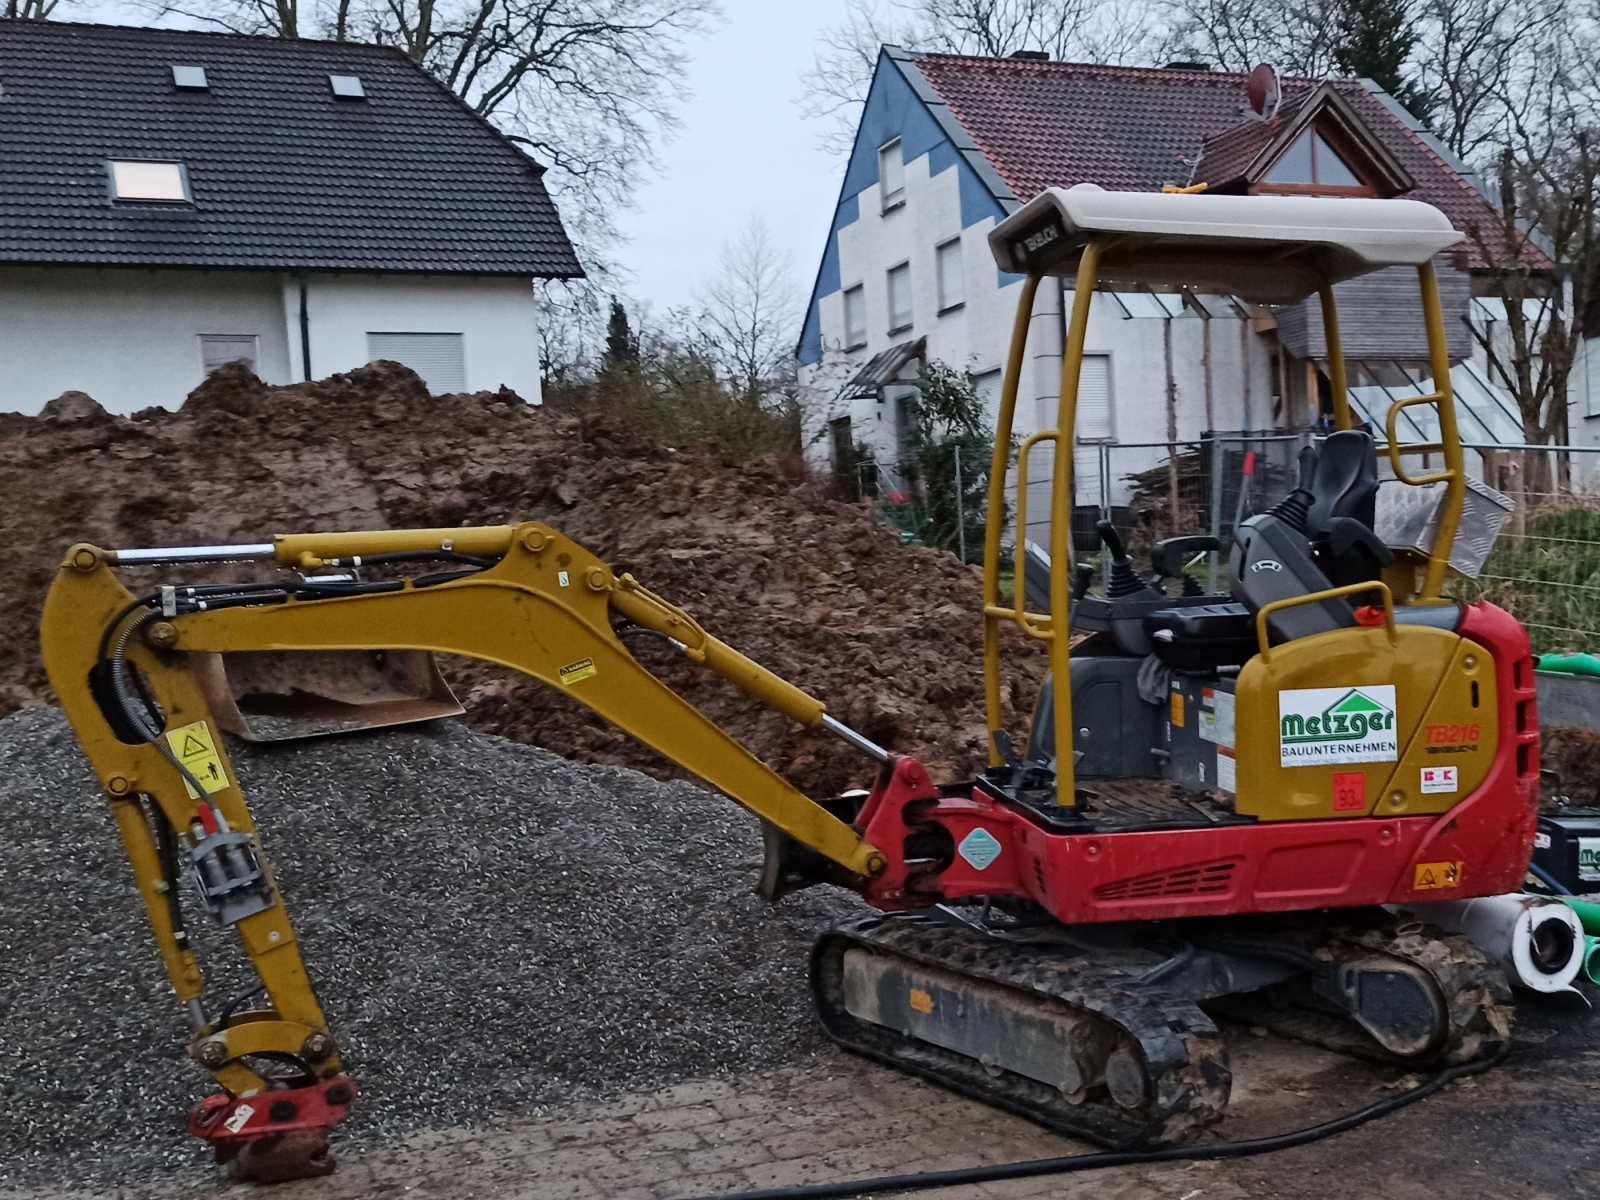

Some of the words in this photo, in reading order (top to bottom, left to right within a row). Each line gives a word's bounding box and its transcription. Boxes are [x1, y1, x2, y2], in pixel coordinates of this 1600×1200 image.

[1281, 710, 1394, 744] metzger
[1425, 723, 1480, 744] TB216
[1282, 742, 1396, 757] BAUUNTERNEHMEN
